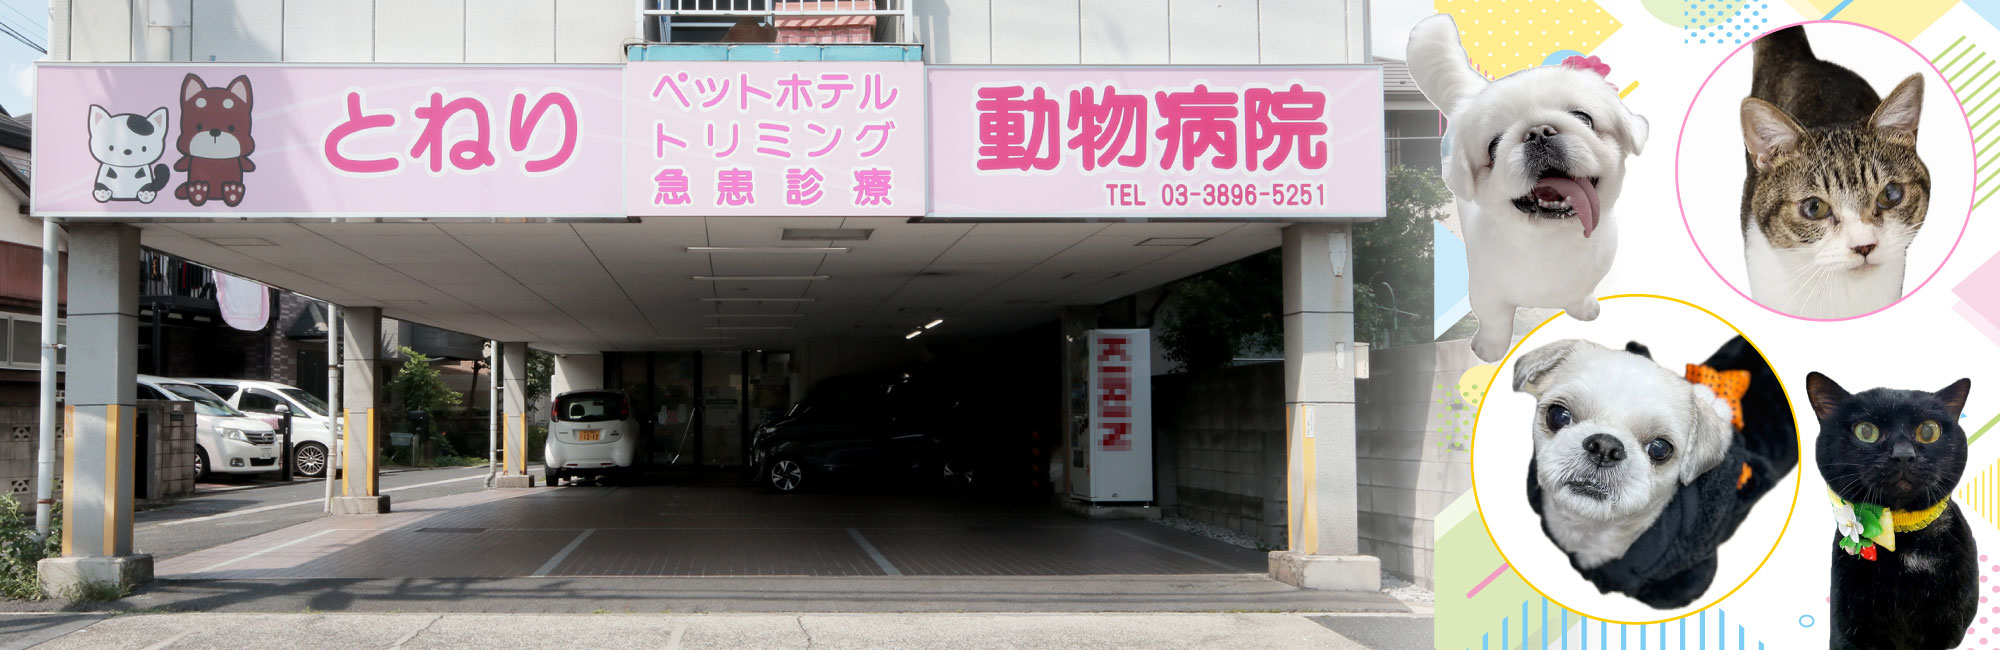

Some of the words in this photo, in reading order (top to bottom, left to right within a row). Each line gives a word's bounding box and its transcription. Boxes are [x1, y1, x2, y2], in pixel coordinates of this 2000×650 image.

[653, 73, 898, 110] ペットホテル
[324, 91, 579, 173] とねり
[656, 120, 896, 158] トリミング
[976, 83, 1328, 172] 動物病院
[654, 167, 892, 206] 急患診療
[1105, 183, 1146, 206] TEL
[1161, 183, 1325, 206] 03-3896-5251
